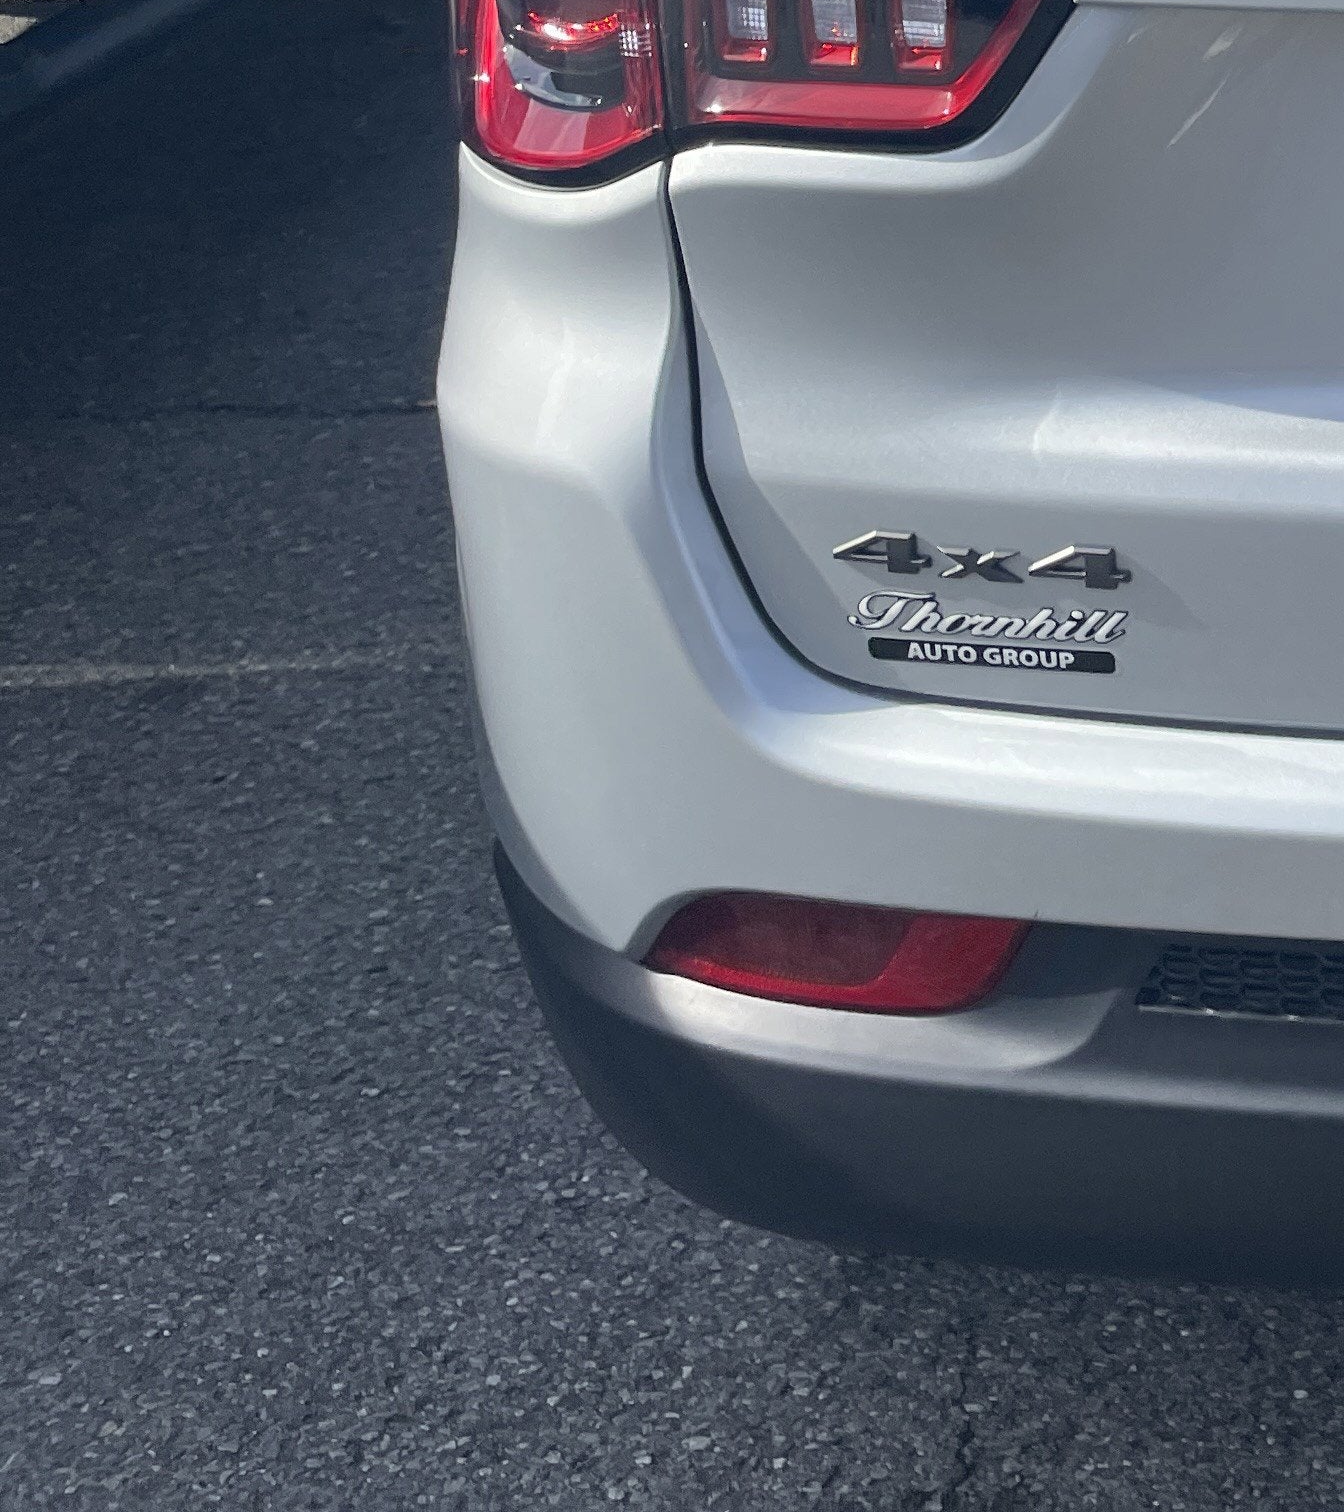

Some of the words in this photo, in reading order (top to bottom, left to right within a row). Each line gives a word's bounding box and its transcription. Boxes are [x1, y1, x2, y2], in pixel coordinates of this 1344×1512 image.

[832, 529, 1133, 590] 4x4
[847, 589, 1129, 644] Thornhill
[908, 641, 978, 665] AUTO
[983, 644, 1076, 670] GROUP
